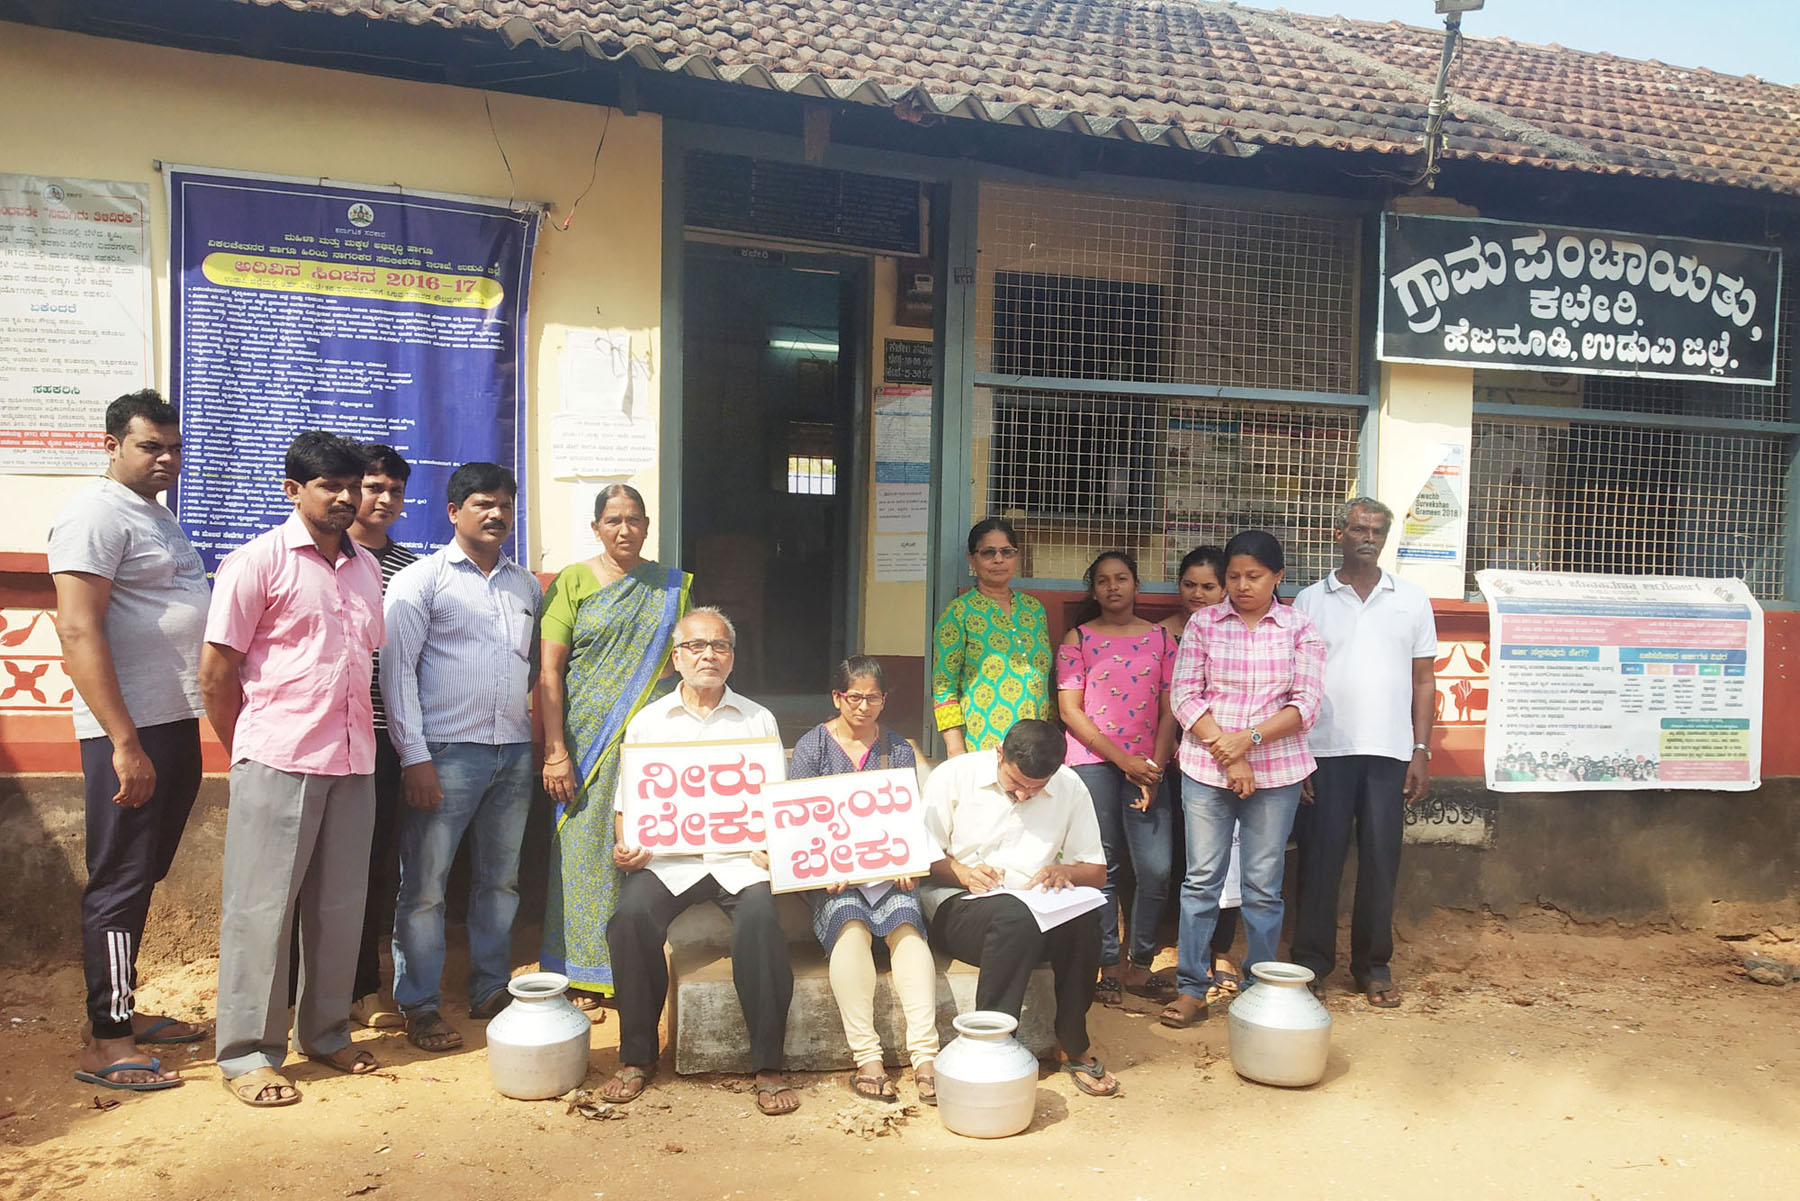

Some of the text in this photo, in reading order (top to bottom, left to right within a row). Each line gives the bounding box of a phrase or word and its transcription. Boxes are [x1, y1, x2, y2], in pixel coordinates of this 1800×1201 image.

[269, 245, 297, 255] ಹಾಗೂ
[319, 236, 340, 248] ಮತ್ತು
[344, 239, 370, 251] ಮಕ್ಕಳ
[407, 245, 434, 255] ಹಾಗೂ
[234, 259, 477, 293] ಅರಿವಿನ ಸಿಂಚನ 2016-17
[1389, 235, 1507, 334] ಗ್ರಾಮ
[1443, 318, 1739, 376] ಹೆಜಮಾಡಿ, ಉಡುಪಿ ಜಿಲ್ಲೆ.
[32, 384, 81, 395] ಸಹಕರಿಸಿ
[1415, 500, 1450, 509] Survekshan
[1415, 507, 1459, 518] Grameen 2018
[637, 752, 767, 800] ನೀರು
[637, 801, 767, 847] ಬೇಕು
[772, 777, 913, 841] ನ್ಯಾಯ
[791, 829, 911, 880] ಬೇಕು
